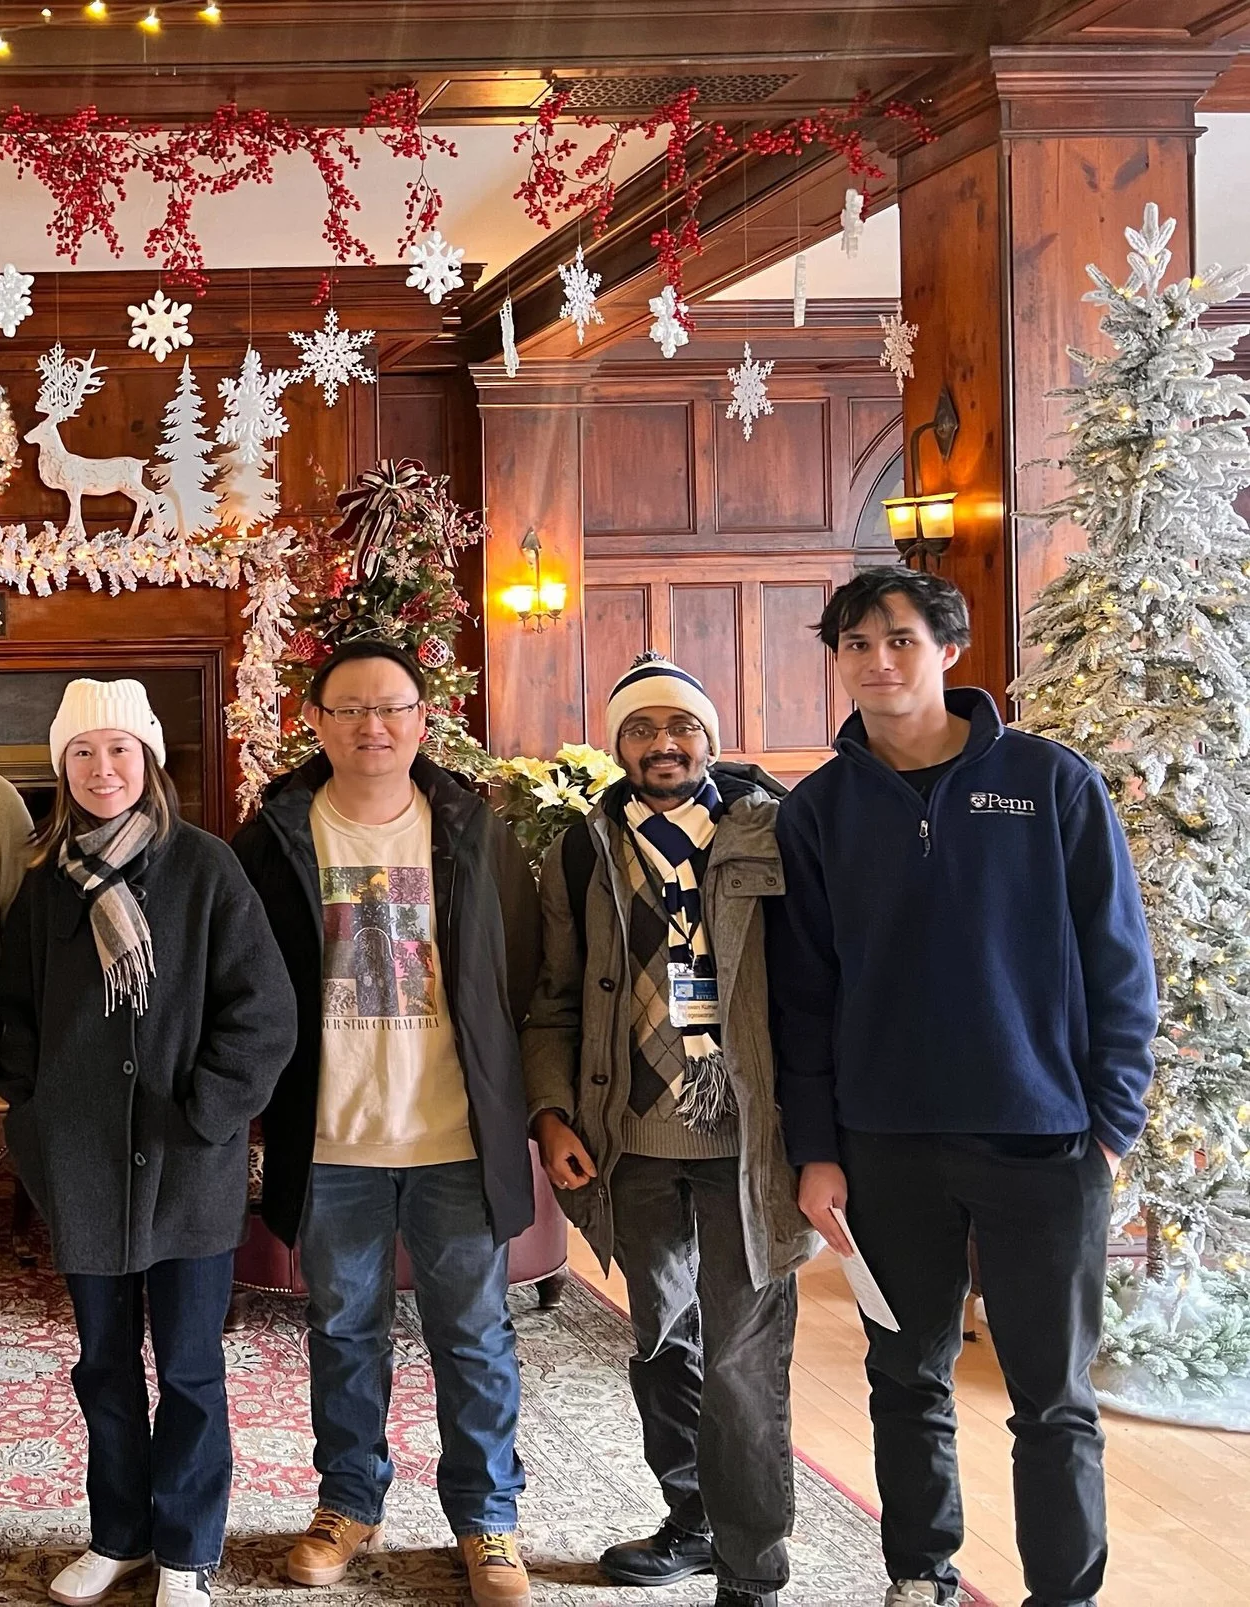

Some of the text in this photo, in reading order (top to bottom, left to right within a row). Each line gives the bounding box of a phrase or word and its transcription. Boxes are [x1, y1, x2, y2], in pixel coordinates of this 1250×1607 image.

[987, 792, 1036, 811] Penn
[343, 1018, 416, 1031] STRUCTURAL
[418, 1017, 440, 1030] ERA
